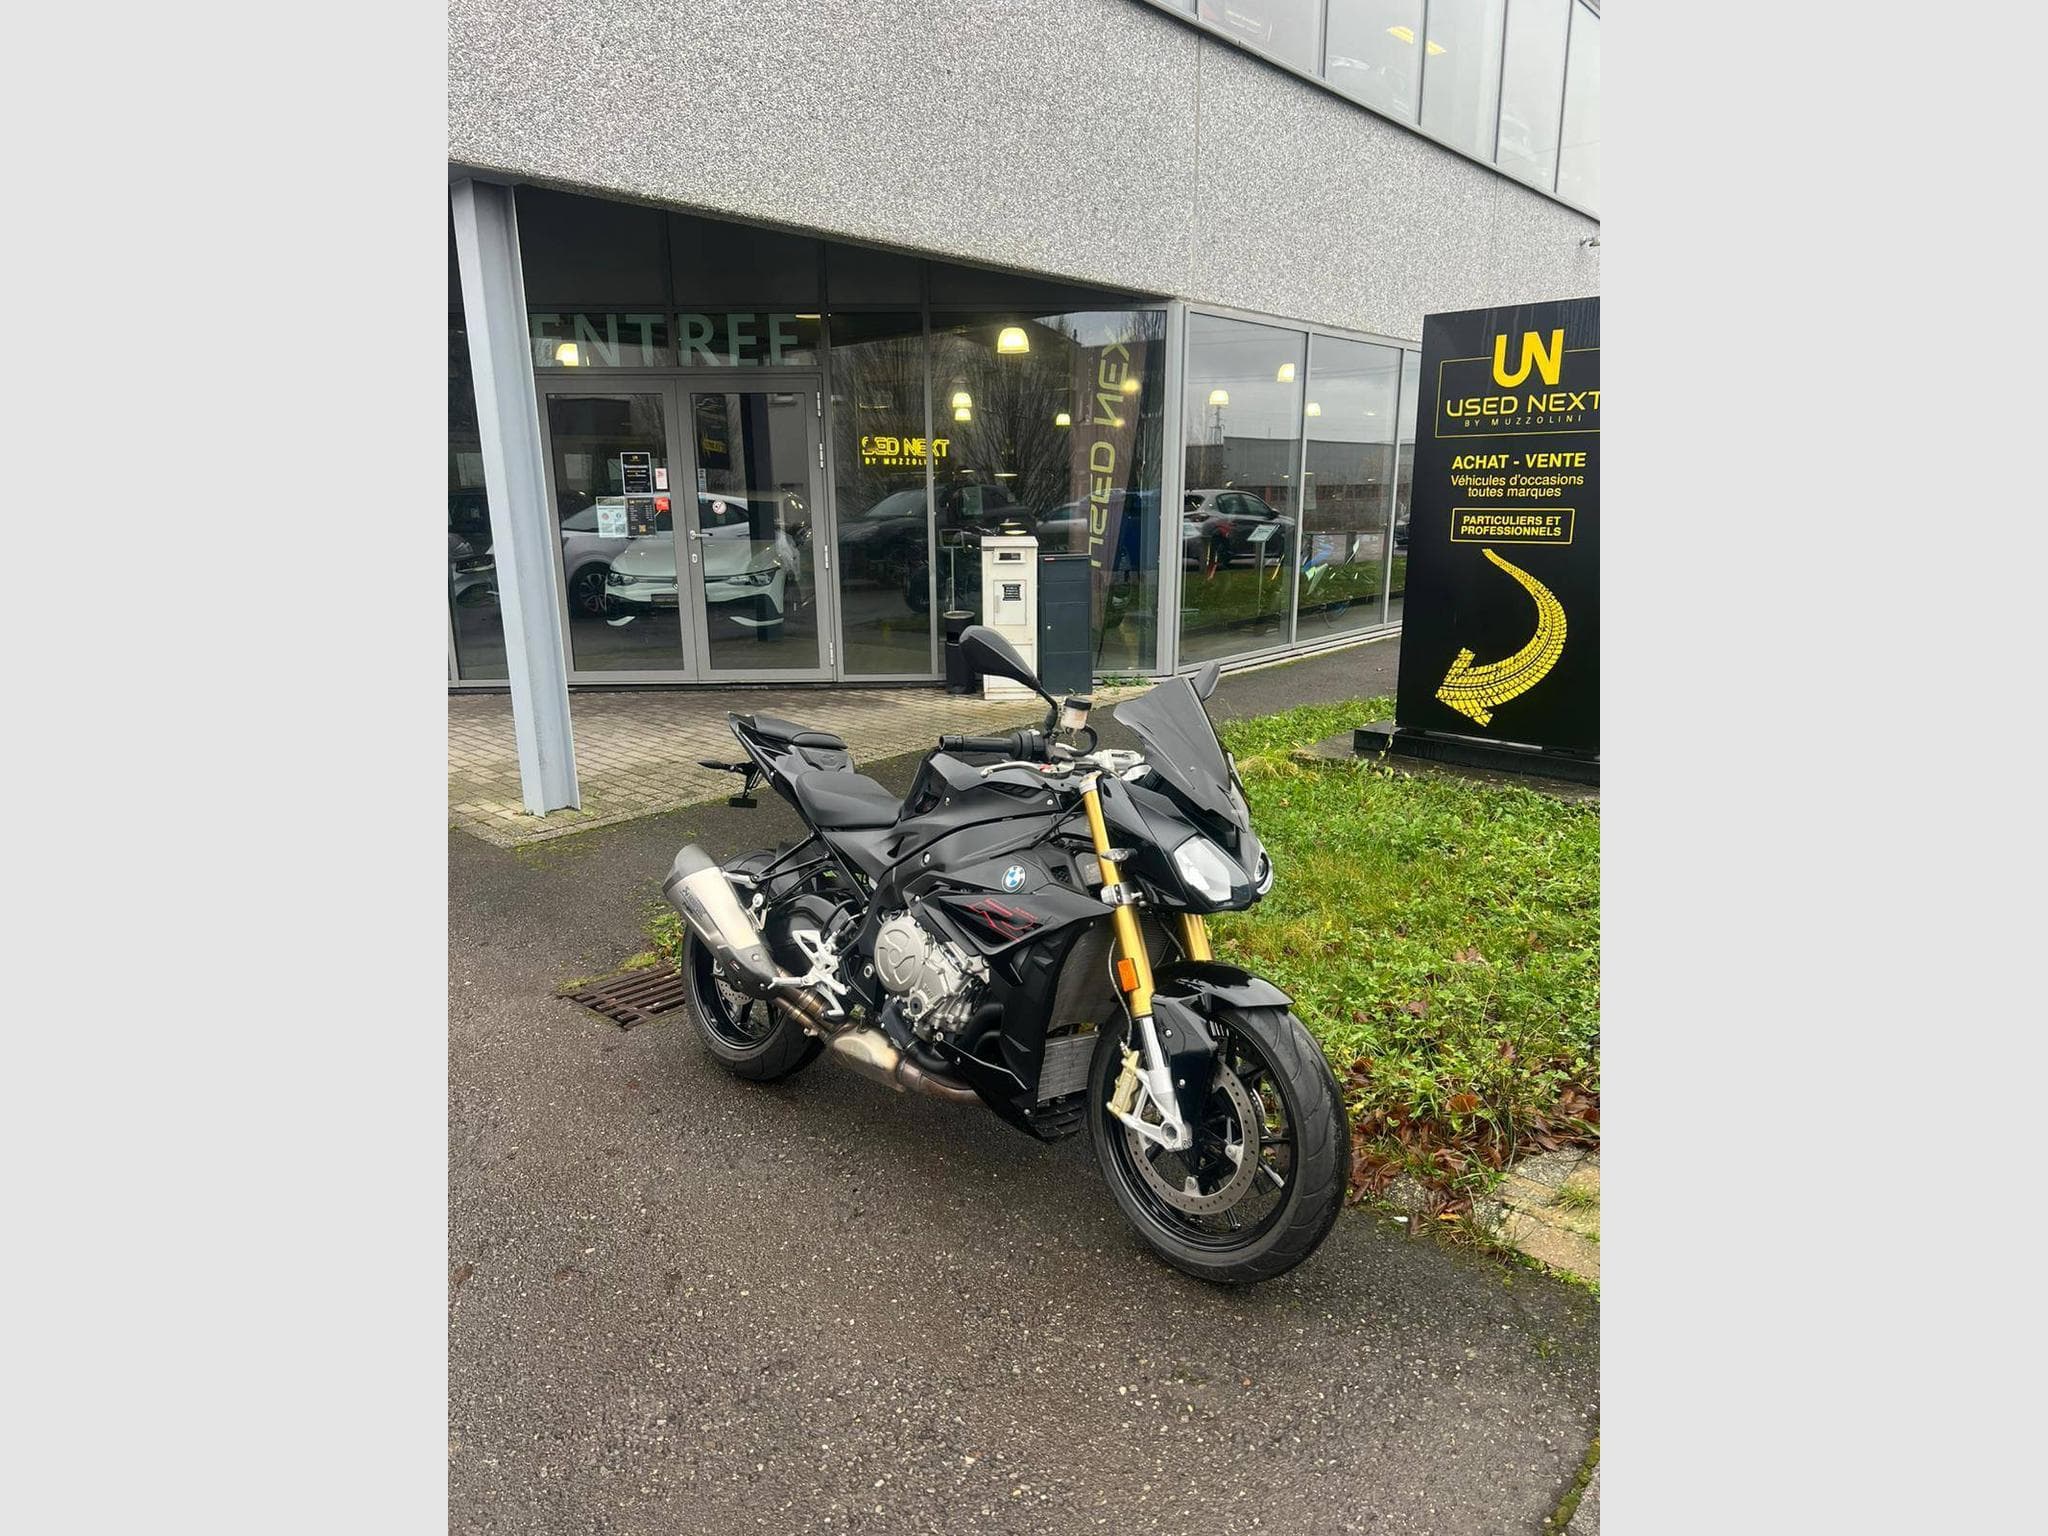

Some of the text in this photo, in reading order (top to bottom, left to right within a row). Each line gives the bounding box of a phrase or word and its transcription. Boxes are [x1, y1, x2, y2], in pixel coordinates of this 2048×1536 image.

[1493, 329, 1564, 388] UN
[1446, 391, 1600, 417] USED NEXT
[1464, 415, 1582, 428] BY MUZZOLINI
[1452, 455, 1509, 470] ACHAT
[1525, 453, 1587, 468] VENTE
[1451, 474, 1584, 486] Véhicules d'occasions
[1468, 487, 1562, 499] toutes marques
[1463, 515, 1561, 526] PARTICULIERS ET
[1461, 526, 1562, 537] PROFESSIONNELS
